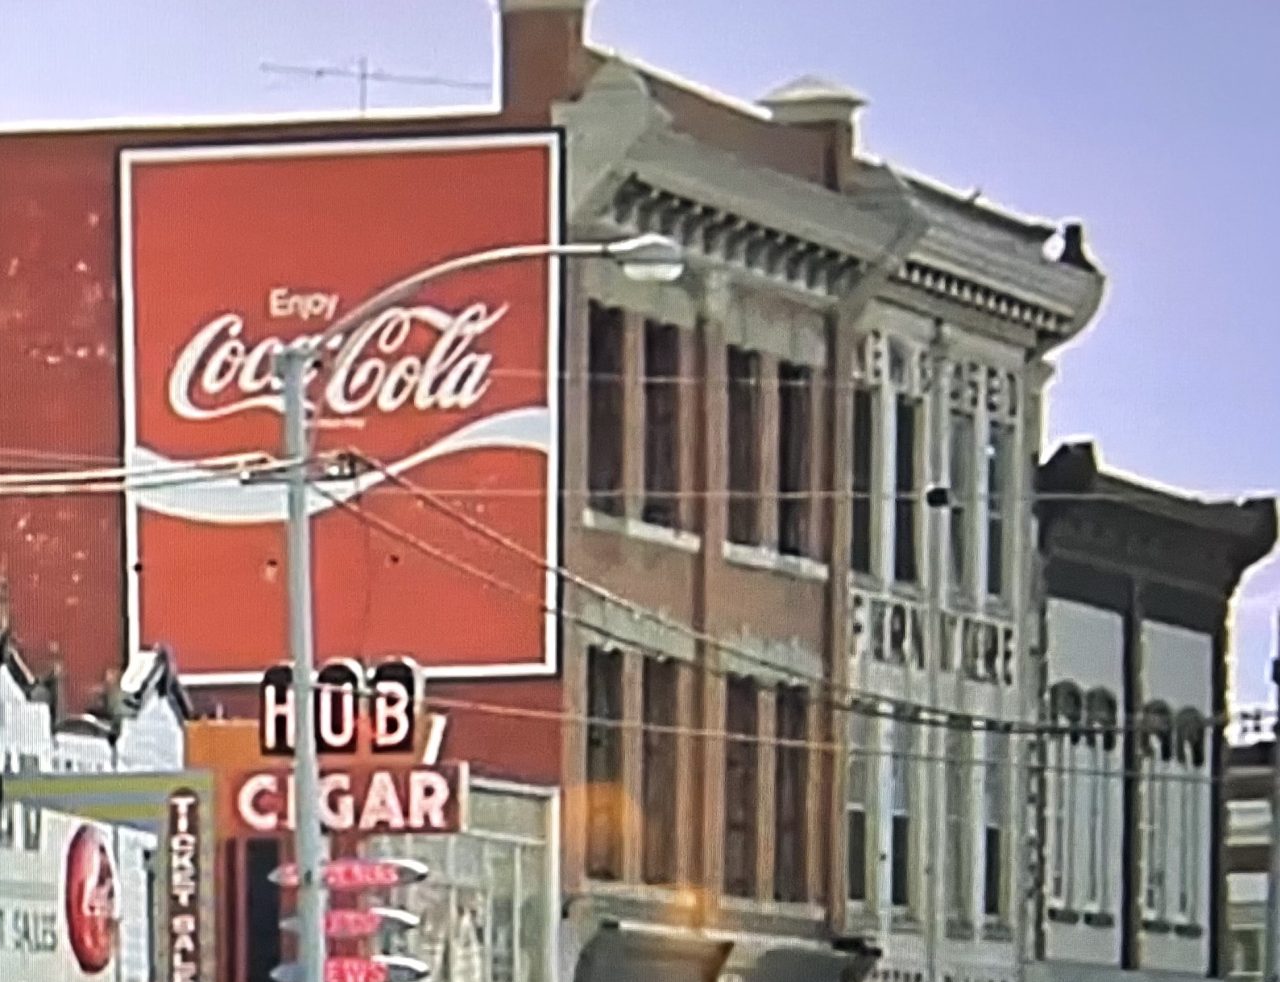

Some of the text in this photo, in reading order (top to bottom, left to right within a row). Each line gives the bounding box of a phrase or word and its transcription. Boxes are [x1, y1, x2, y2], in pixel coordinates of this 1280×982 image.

[269, 288, 339, 321] Enjoy
[265, 682, 410, 748] HUB
[238, 771, 450, 831] CIGAR
